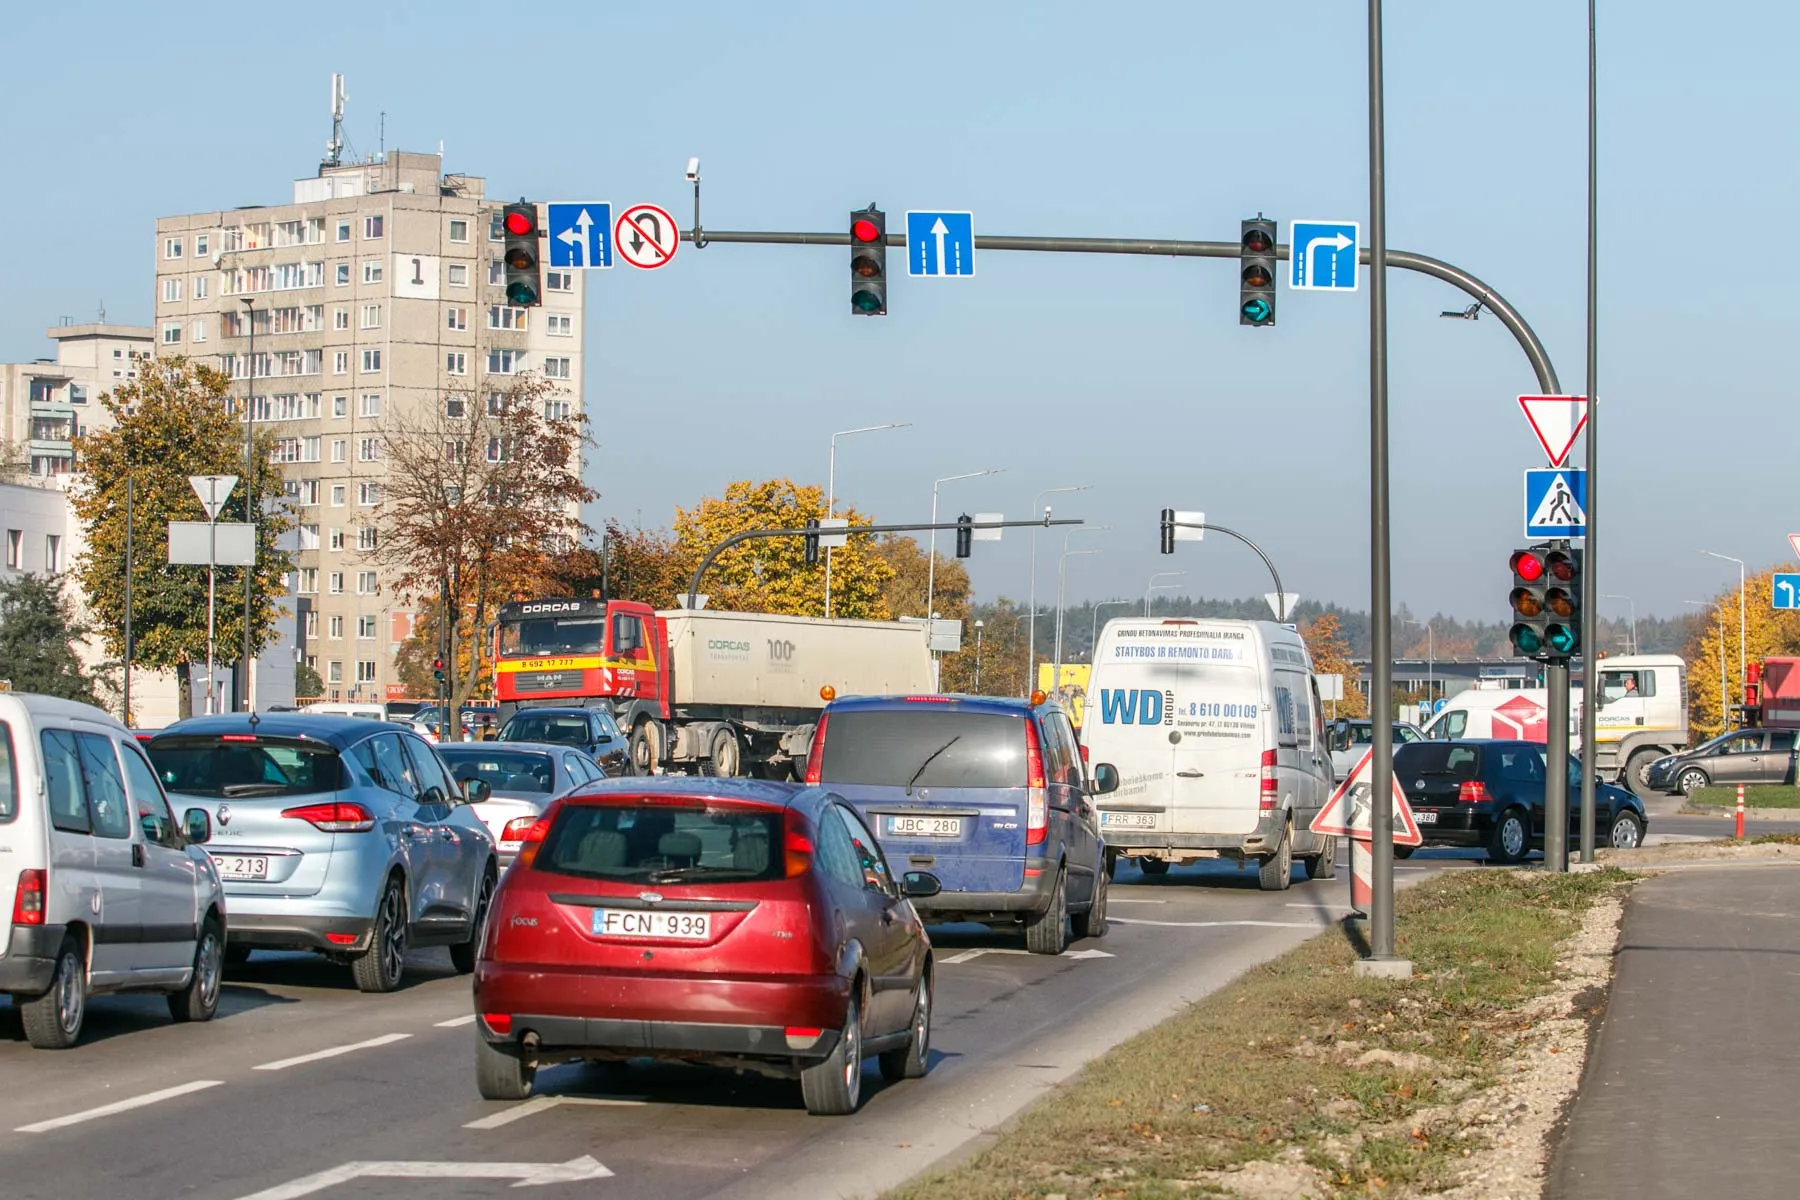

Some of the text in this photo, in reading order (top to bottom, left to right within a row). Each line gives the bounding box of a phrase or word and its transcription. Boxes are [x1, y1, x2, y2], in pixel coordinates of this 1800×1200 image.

[411, 258, 424, 285] 1
[522, 603, 580, 614] DORCAS
[708, 639, 750, 651] DORCAS
[1115, 646, 1155, 658] STATYBOS
[1158, 647, 1166, 658] IR
[1168, 647, 1209, 659] REMONTO
[547, 659, 555, 667] 17
[1100, 688, 1163, 726] WD
[1164, 689, 1175, 726] GROUP
[1189, 702, 1196, 716] 8
[1199, 703, 1220, 717] 610
[1223, 703, 1257, 719] 00109
[896, 819, 958, 832] JBC 280
[1107, 814, 1155, 826] FRR 363
[234, 858, 264, 873] 213
[604, 912, 652, 933] FCN
[667, 914, 706, 936] 939
